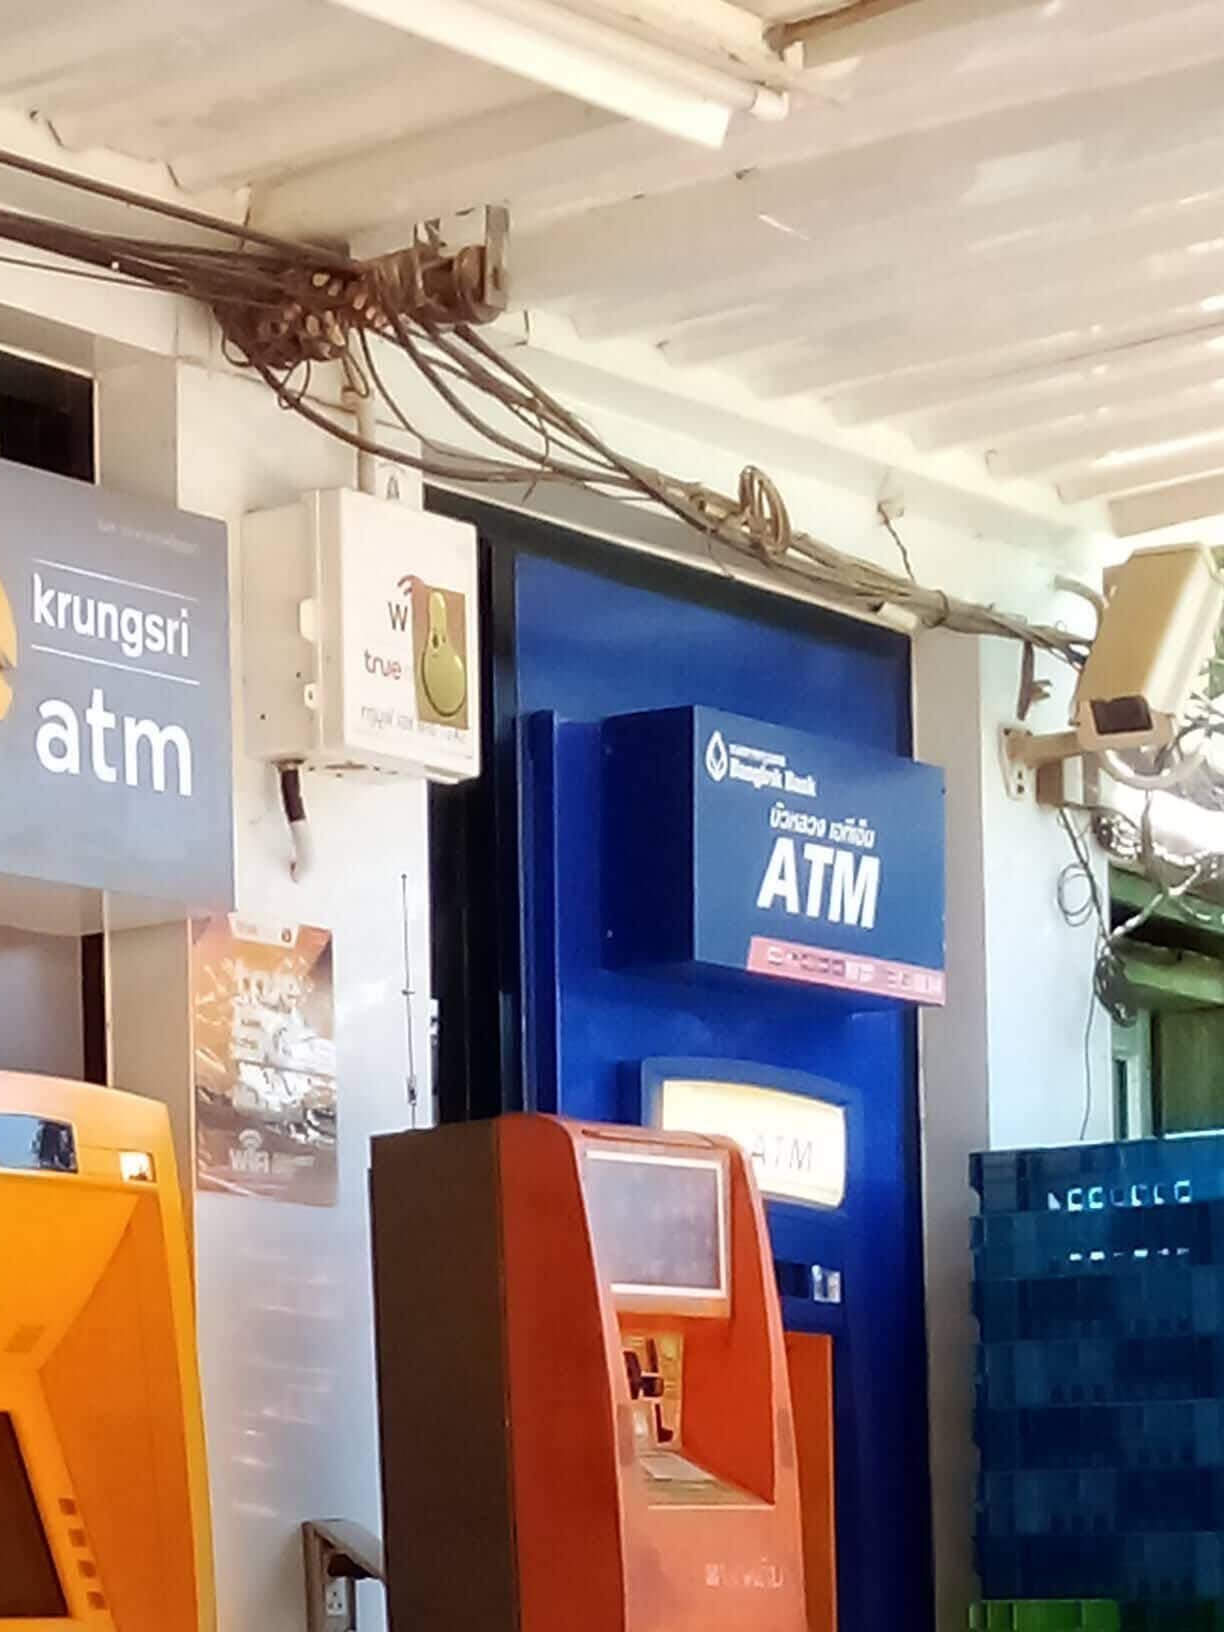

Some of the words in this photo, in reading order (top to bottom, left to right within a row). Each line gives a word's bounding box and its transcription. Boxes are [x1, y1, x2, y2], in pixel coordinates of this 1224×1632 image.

[33, 572, 189, 657] krungsri
[35, 688, 193, 797] atm
[756, 836, 880, 930] ATM
